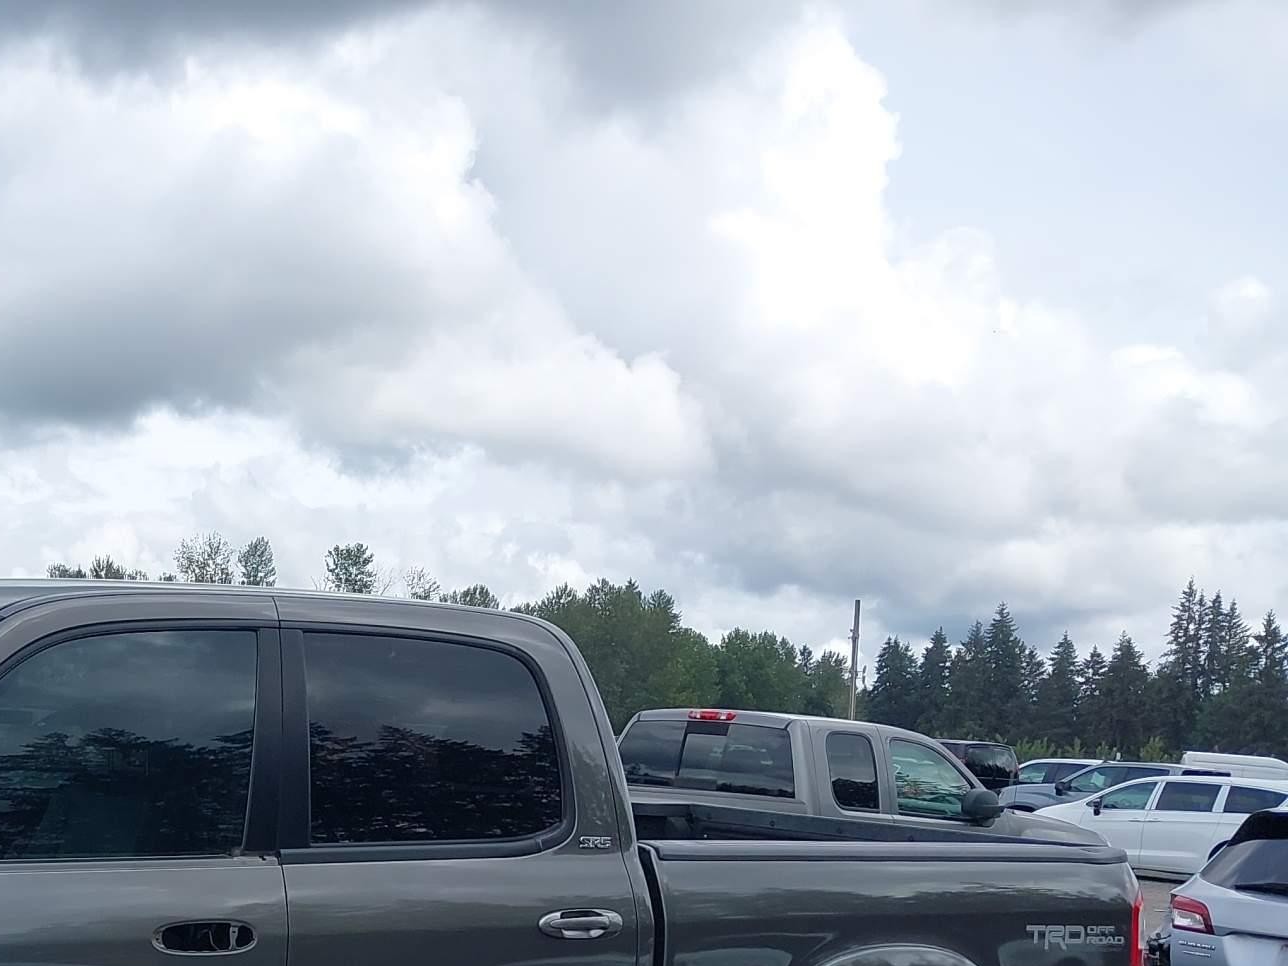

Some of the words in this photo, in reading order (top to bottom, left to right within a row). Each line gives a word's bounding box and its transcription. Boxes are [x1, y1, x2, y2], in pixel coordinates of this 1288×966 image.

[1086, 925, 1115, 934] OFF
[1026, 924, 1085, 951] TRD
[1086, 936, 1125, 945] ROAD
